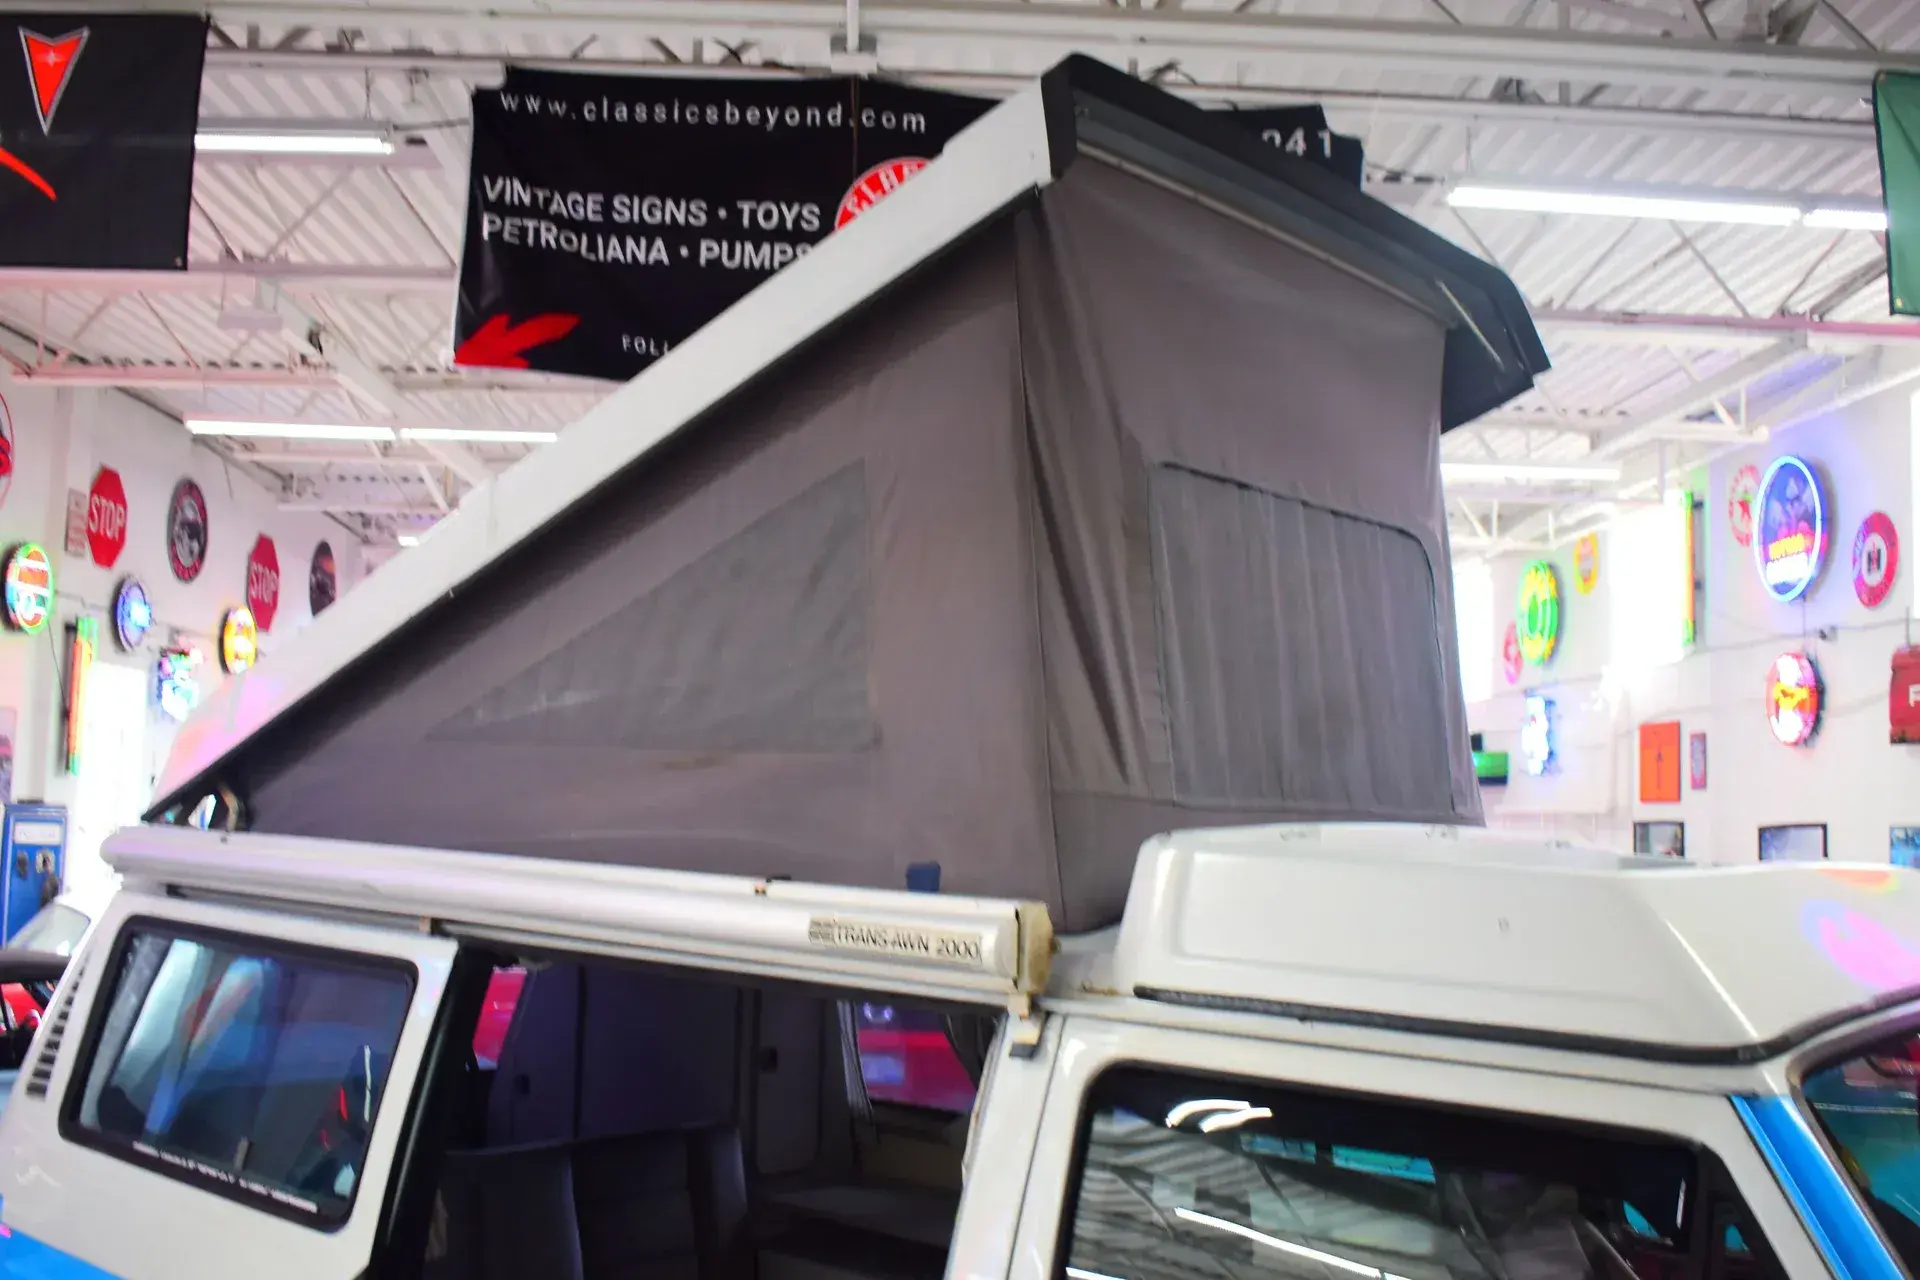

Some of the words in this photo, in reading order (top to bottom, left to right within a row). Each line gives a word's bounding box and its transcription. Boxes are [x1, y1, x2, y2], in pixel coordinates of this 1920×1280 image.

[501, 90, 925, 134] www.classicsbeyond.com
[482, 174, 605, 222] VINTAGE
[611, 193, 708, 228] SIGNS
[737, 200, 821, 232] TOYS
[482, 211, 670, 267] PETROLIANA
[89, 493, 126, 541] STOP
[249, 561, 279, 607] STOP
[936, 937, 981, 960] 2000
